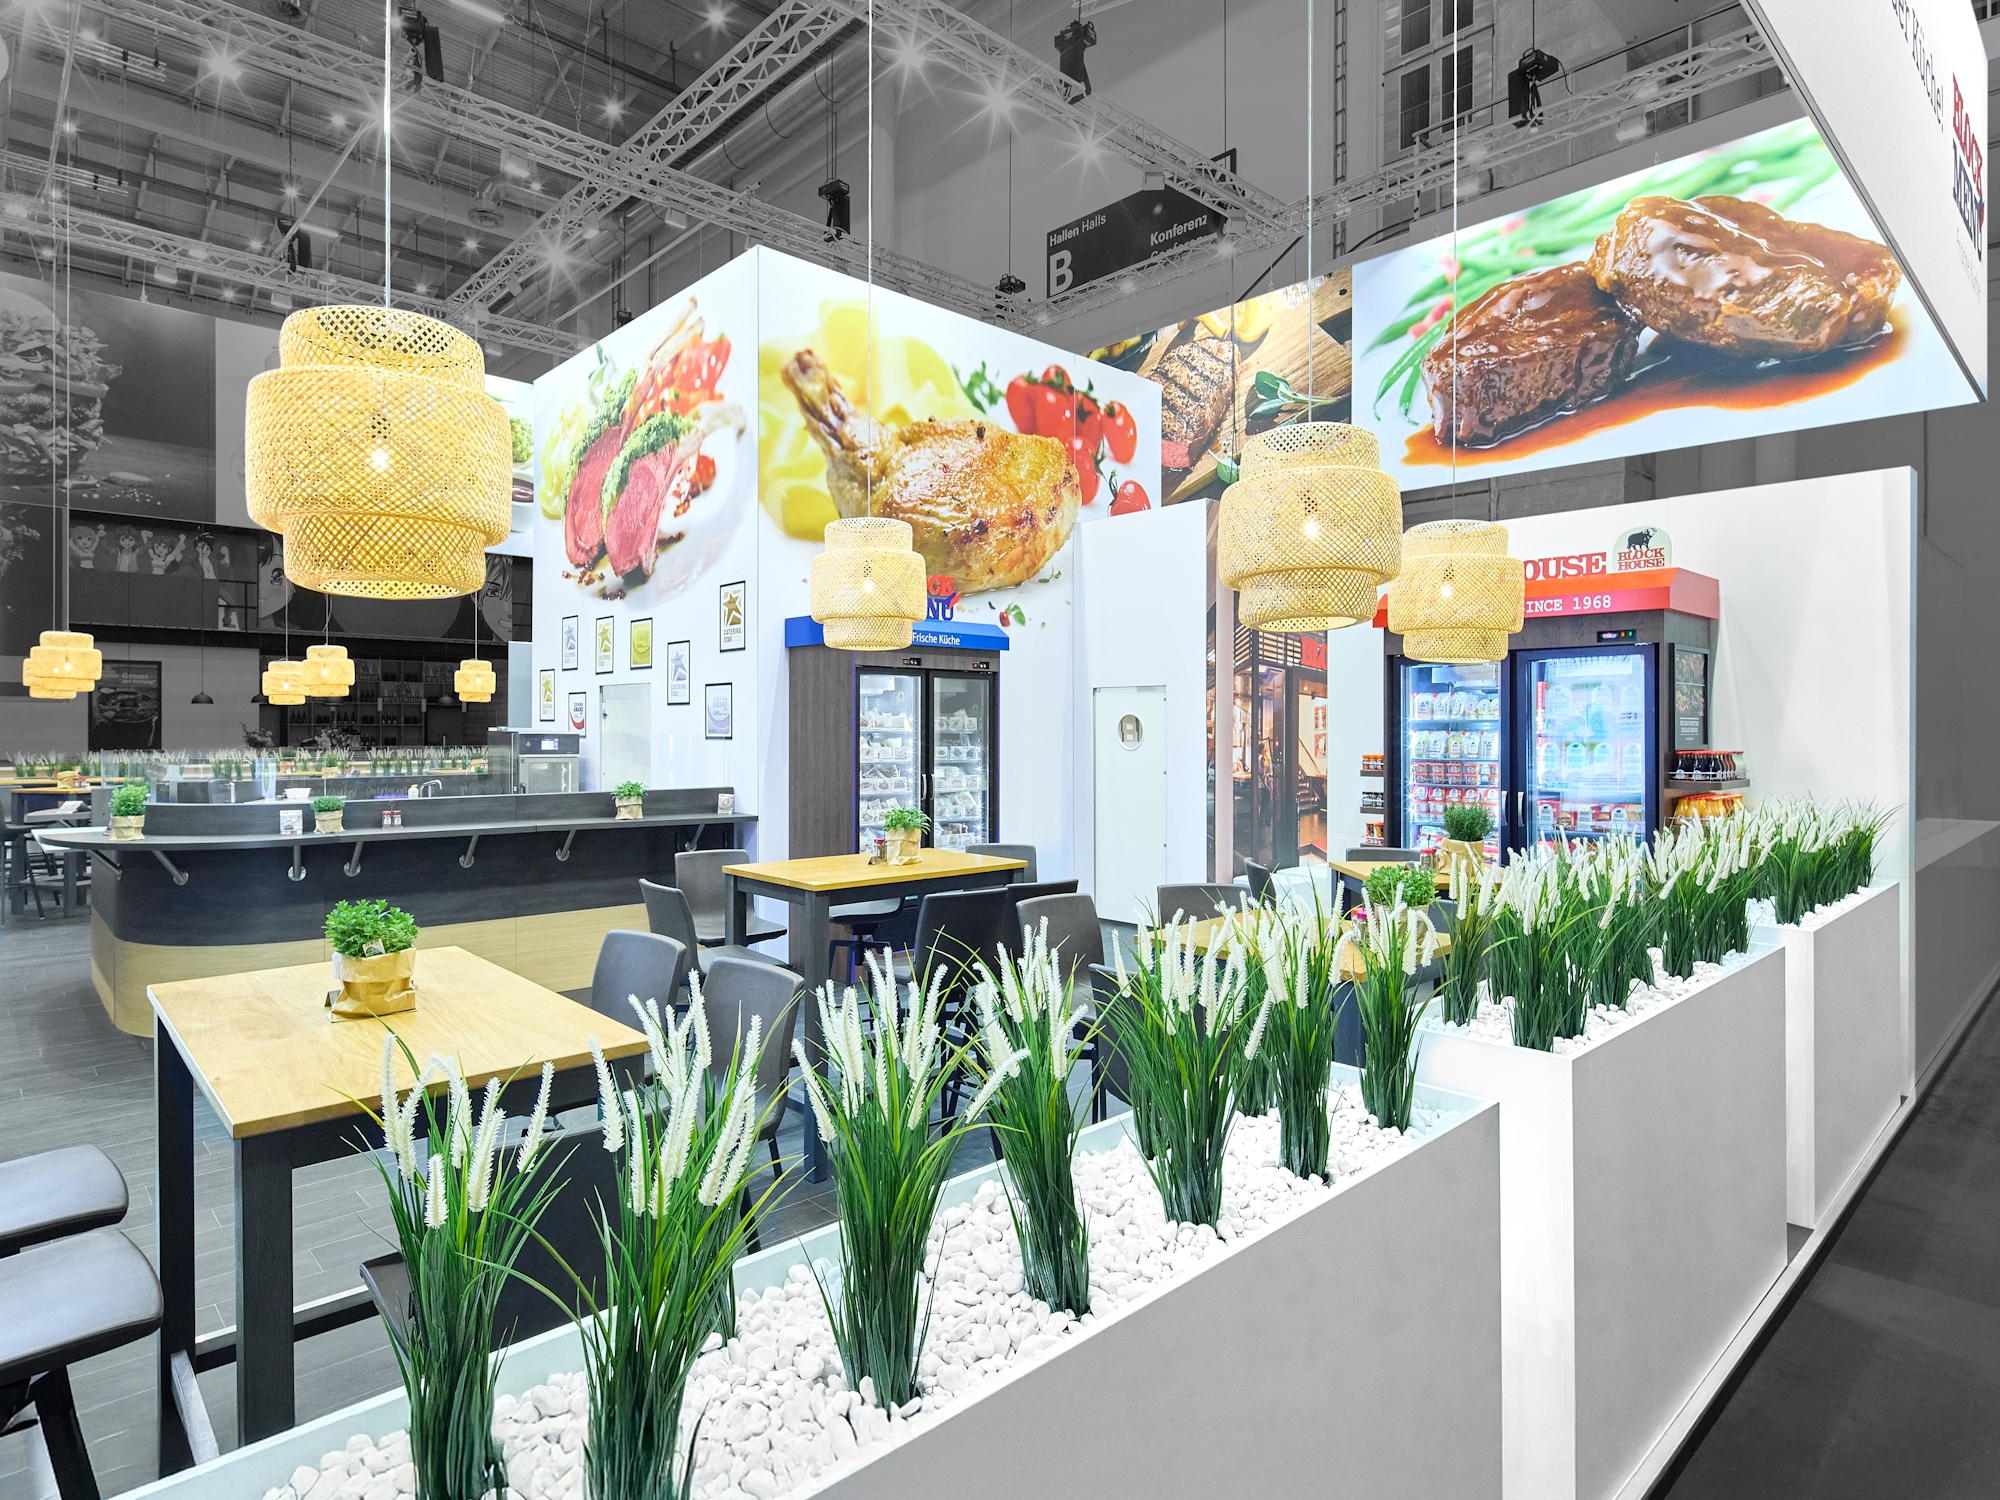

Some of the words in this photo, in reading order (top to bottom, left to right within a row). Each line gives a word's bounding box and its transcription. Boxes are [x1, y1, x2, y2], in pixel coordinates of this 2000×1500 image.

[1912, 8, 1944, 132] Küche!
[1952, 72, 1983, 197] BLOCK
[1049, 226, 1079, 247] Hallen
[1081, 213, 1107, 235] Halls
[1150, 214, 1208, 247] Konferenz
[1049, 249, 1074, 296] B
[1617, 547, 1665, 561] BLOCK
[1617, 558, 1665, 571] HOUSE
[1523, 552, 1606, 581] OUSE
[1524, 598, 1563, 613] INCE
[1572, 594, 1612, 611] 1968
[723, 627, 742, 636] CATERING
[912, 632, 938, 644] Frische
[938, 634, 961, 646] Küche
[121, 672, 149, 680] Genuss
